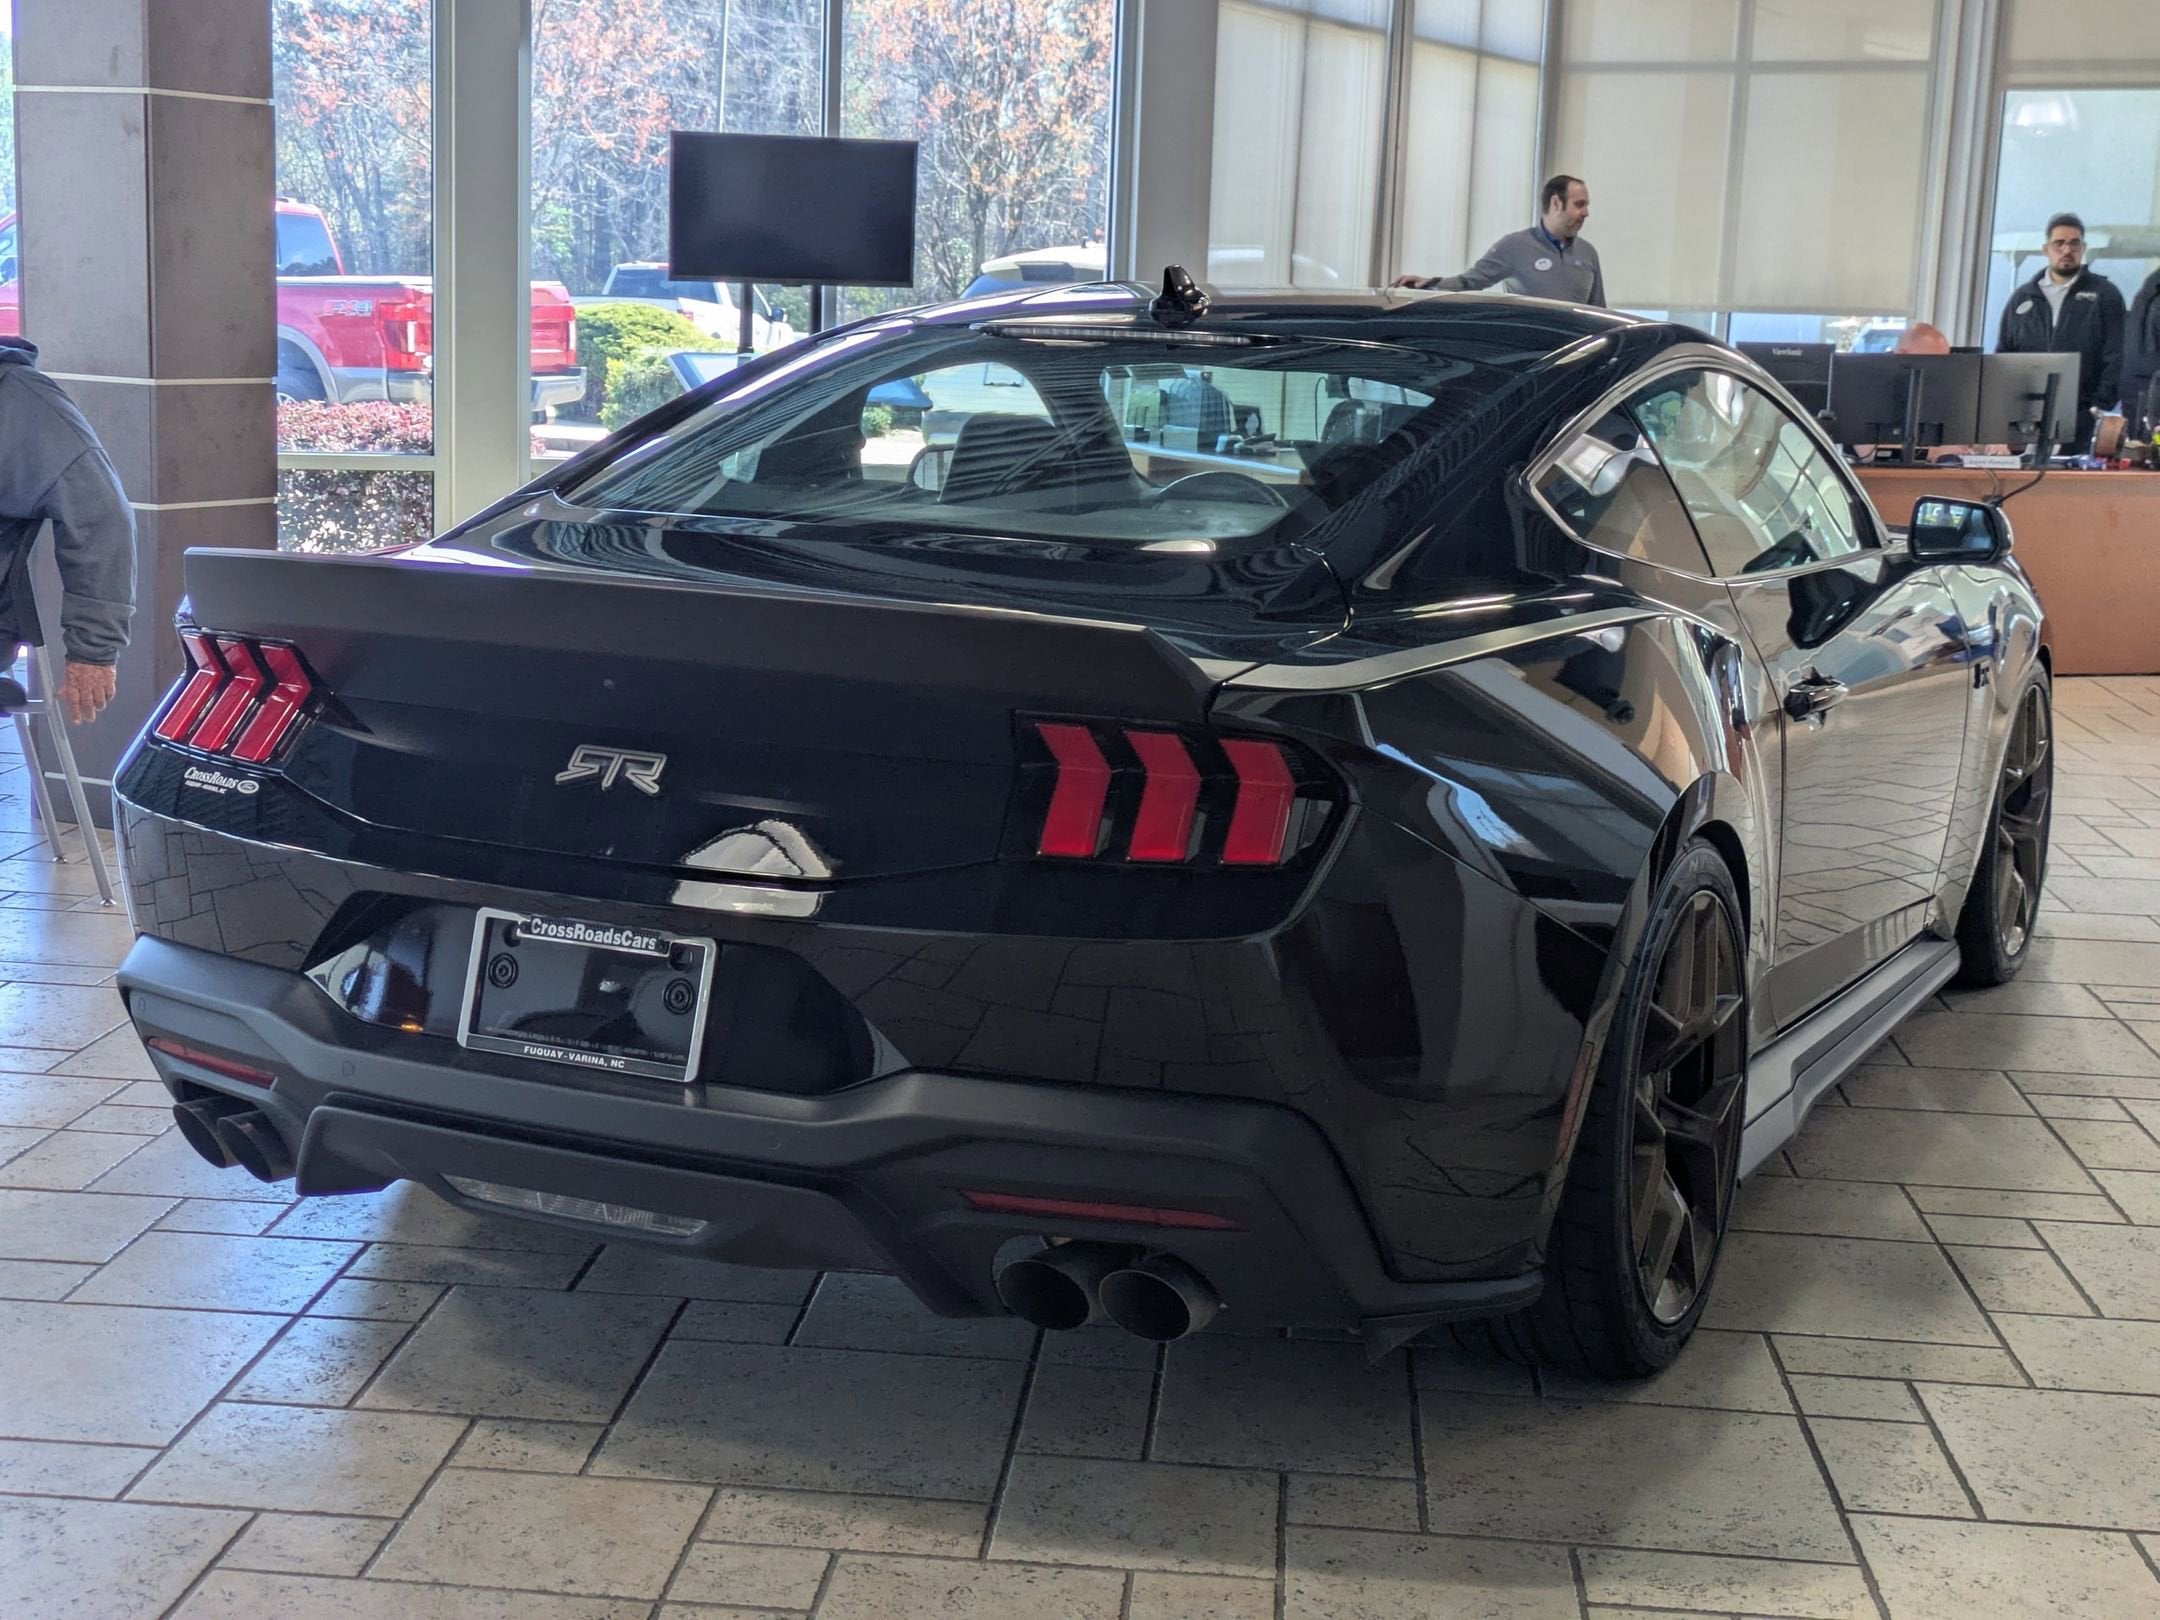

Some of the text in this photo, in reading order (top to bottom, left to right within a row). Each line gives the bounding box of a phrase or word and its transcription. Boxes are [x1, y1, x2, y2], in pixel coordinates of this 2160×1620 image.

[531, 918, 657, 950] CrossRoadsCars
[523, 1045, 625, 1069] FUQUAY-VARINA, NC
